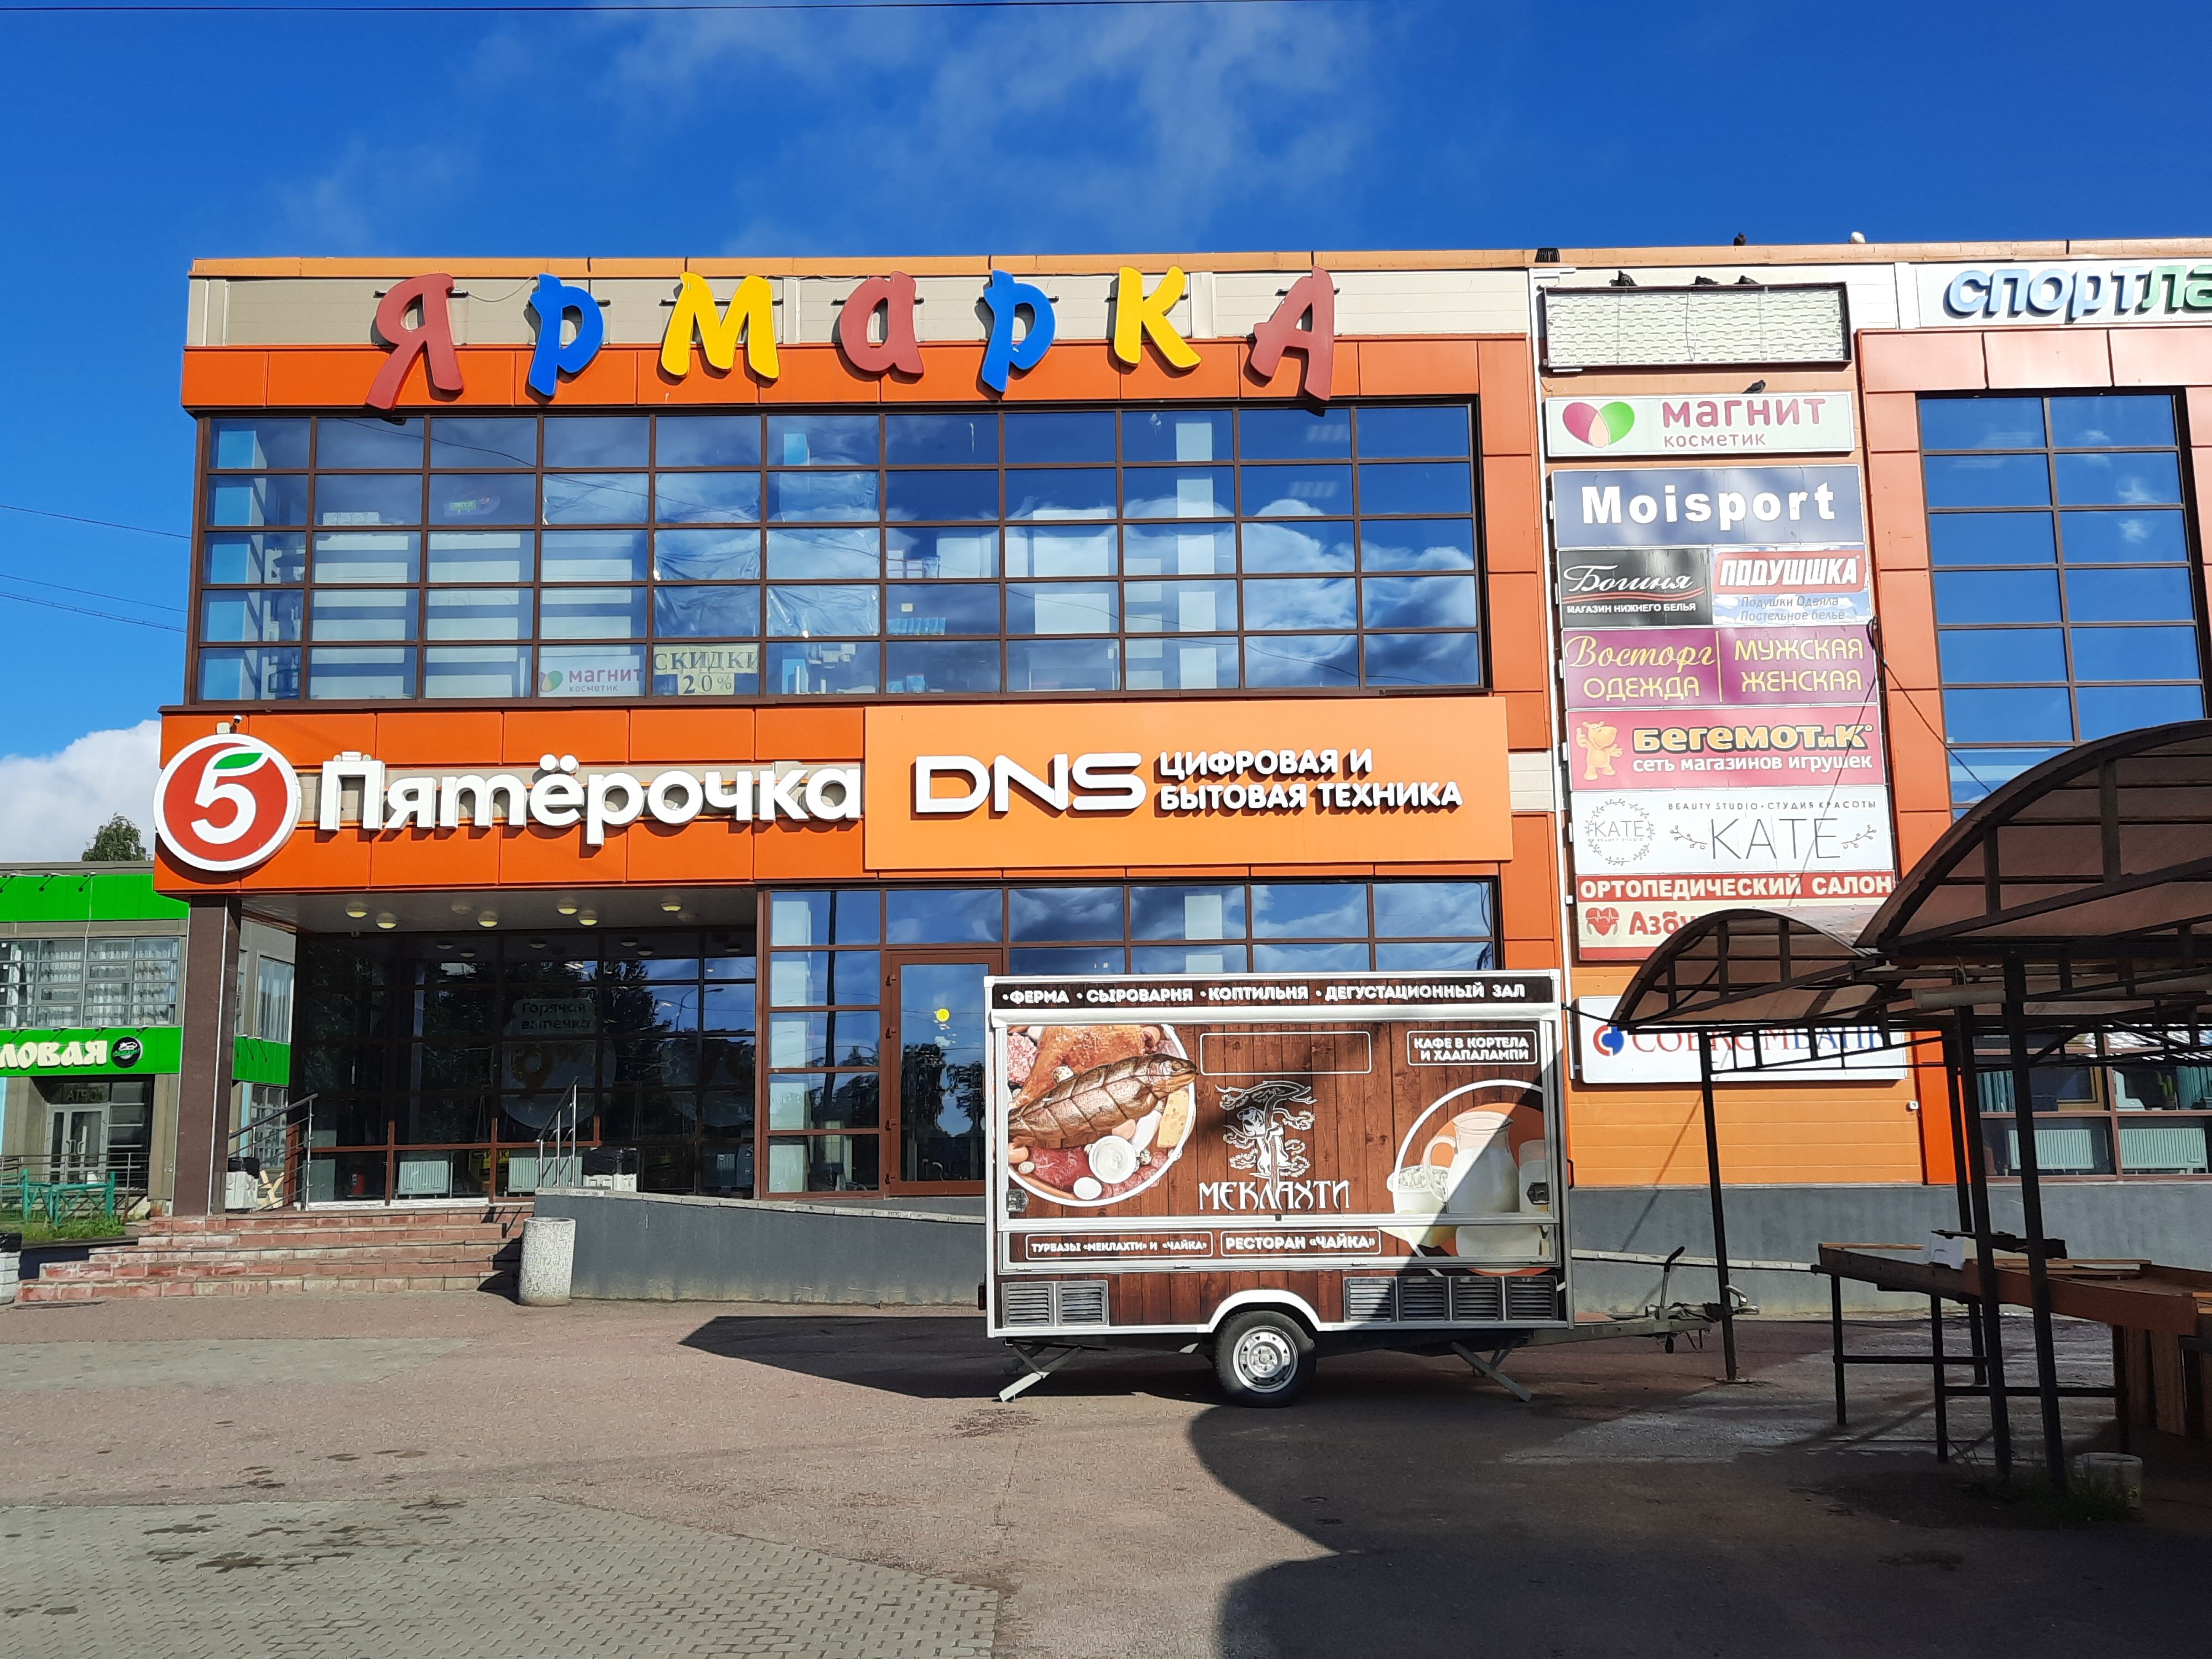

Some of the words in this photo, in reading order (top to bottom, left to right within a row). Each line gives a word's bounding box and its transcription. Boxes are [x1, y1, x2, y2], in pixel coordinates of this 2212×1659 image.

[1662, 398, 1826, 428] магнит
[1663, 433, 1766, 447] косметик
[1581, 482, 1836, 531] Moisport
[1563, 564, 1694, 593] Богиня
[1719, 557, 1858, 587] ПОДУШШКА
[1567, 604, 1612, 613] МАГАЗИН
[1614, 604, 1662, 613] НИЖНЕГО
[1663, 603, 1697, 612] БЕЛЬЯ
[1740, 596, 1793, 609] Подушки
[1797, 595, 1839, 607] Одеяла
[1740, 610, 1808, 622] Постельное
[1564, 635, 1716, 673] Восторг
[1734, 638, 1865, 661] МУЖСКАЯ
[654, 650, 758, 674] СКИДКИ
[568, 669, 643, 684] магнит
[1741, 670, 1863, 692] ЖЕНСКАЯ
[1583, 676, 1700, 702] ОДЕЖДА
[1159, 749, 1338, 781] ЦИФРОВАЯ
[1348, 748, 1373, 773] И
[1632, 759, 1675, 772] сеть
[1681, 757, 1783, 771] магазинов
[1788, 755, 1873, 773] игрушек
[914, 752, 1146, 814] DNS
[317, 753, 864, 847] Пятёрочка
[1159, 782, 1308, 810] БЫТОВАЯ
[1316, 780, 1464, 807] ТЕХНИКА
[1594, 821, 1646, 837] KATE
[1711, 818, 1841, 859] KATE
[1580, 874, 1802, 900] ОРТОПЕДИЧЕСКИЙ
[1812, 875, 1893, 895] САЛОН
[1010, 989, 1070, 1004] ФЕРМА
[1086, 988, 1193, 1002] СЫРОВАРНЯ
[1208, 986, 1308, 1000] КОПТИЛЬНЯ
[1325, 982, 1485, 1001] ДЕГУСТАЦИОННЫЙ
[1492, 984, 1525, 998] ЗАЛ
[1414, 1037, 1452, 1049] КАФЕ
[1455, 1037, 1464, 1048] В
[1467, 1037, 1529, 1048] КОРТЕЛА
[1421, 1050, 1431, 1061] И
[1434, 1048, 1529, 1061] ХААПАЛАМПИ
[1199, 1179, 1350, 1211] МЕКЛАХТИ
[1031, 1243, 1081, 1253] ТУРБАЗЫ
[1083, 1242, 1147, 1251] «МЕКЛАХТИ»
[1150, 1241, 1158, 1250] И
[1162, 1239, 1208, 1250] «ЧАЙКА»
[1226, 1237, 1306, 1250] РЕСТОРАН
[1309, 1233, 1376, 1249] «ЧАЙКА»
